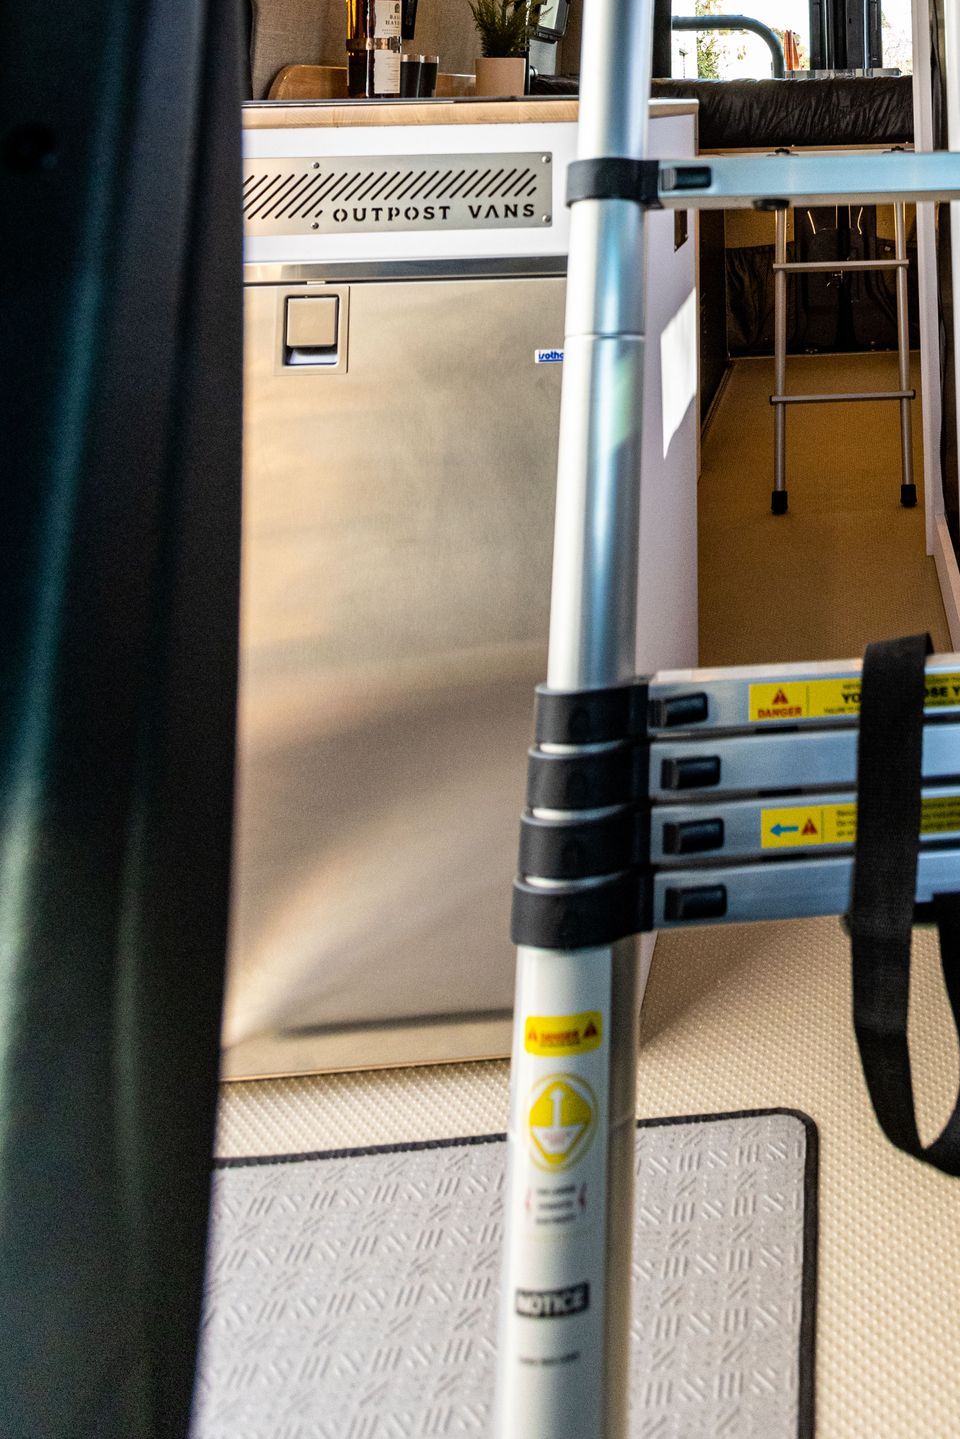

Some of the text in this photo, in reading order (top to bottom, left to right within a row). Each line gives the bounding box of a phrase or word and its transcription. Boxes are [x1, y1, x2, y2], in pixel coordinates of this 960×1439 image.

[333, 203, 535, 222] OUTPOST VANS
[841, 693, 862, 704] YO
[924, 685, 948, 697] OSE
[757, 707, 802, 718] DANGER
